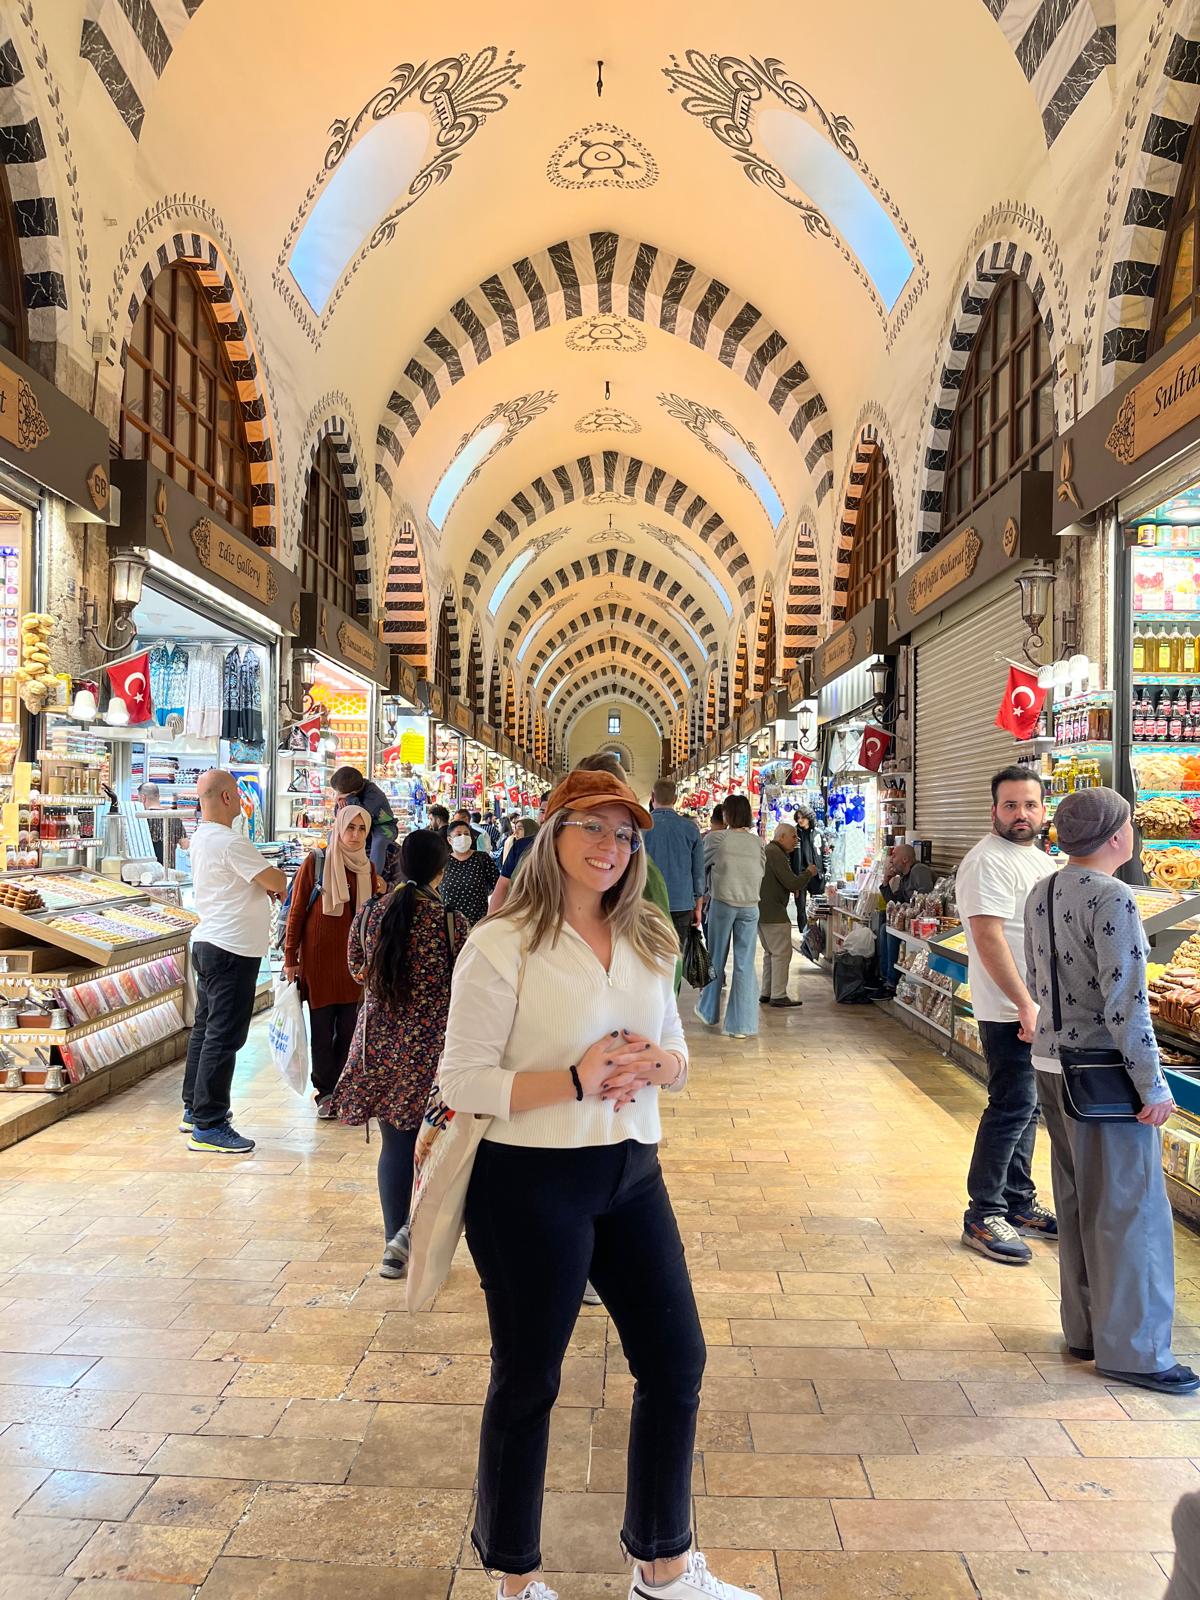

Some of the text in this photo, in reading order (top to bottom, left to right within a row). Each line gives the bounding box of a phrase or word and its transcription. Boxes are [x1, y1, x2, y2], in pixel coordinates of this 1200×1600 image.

[94, 474, 107, 498] 68
[218, 541, 261, 588] Ediz Gallery
[939, 549, 965, 580] Baharat
